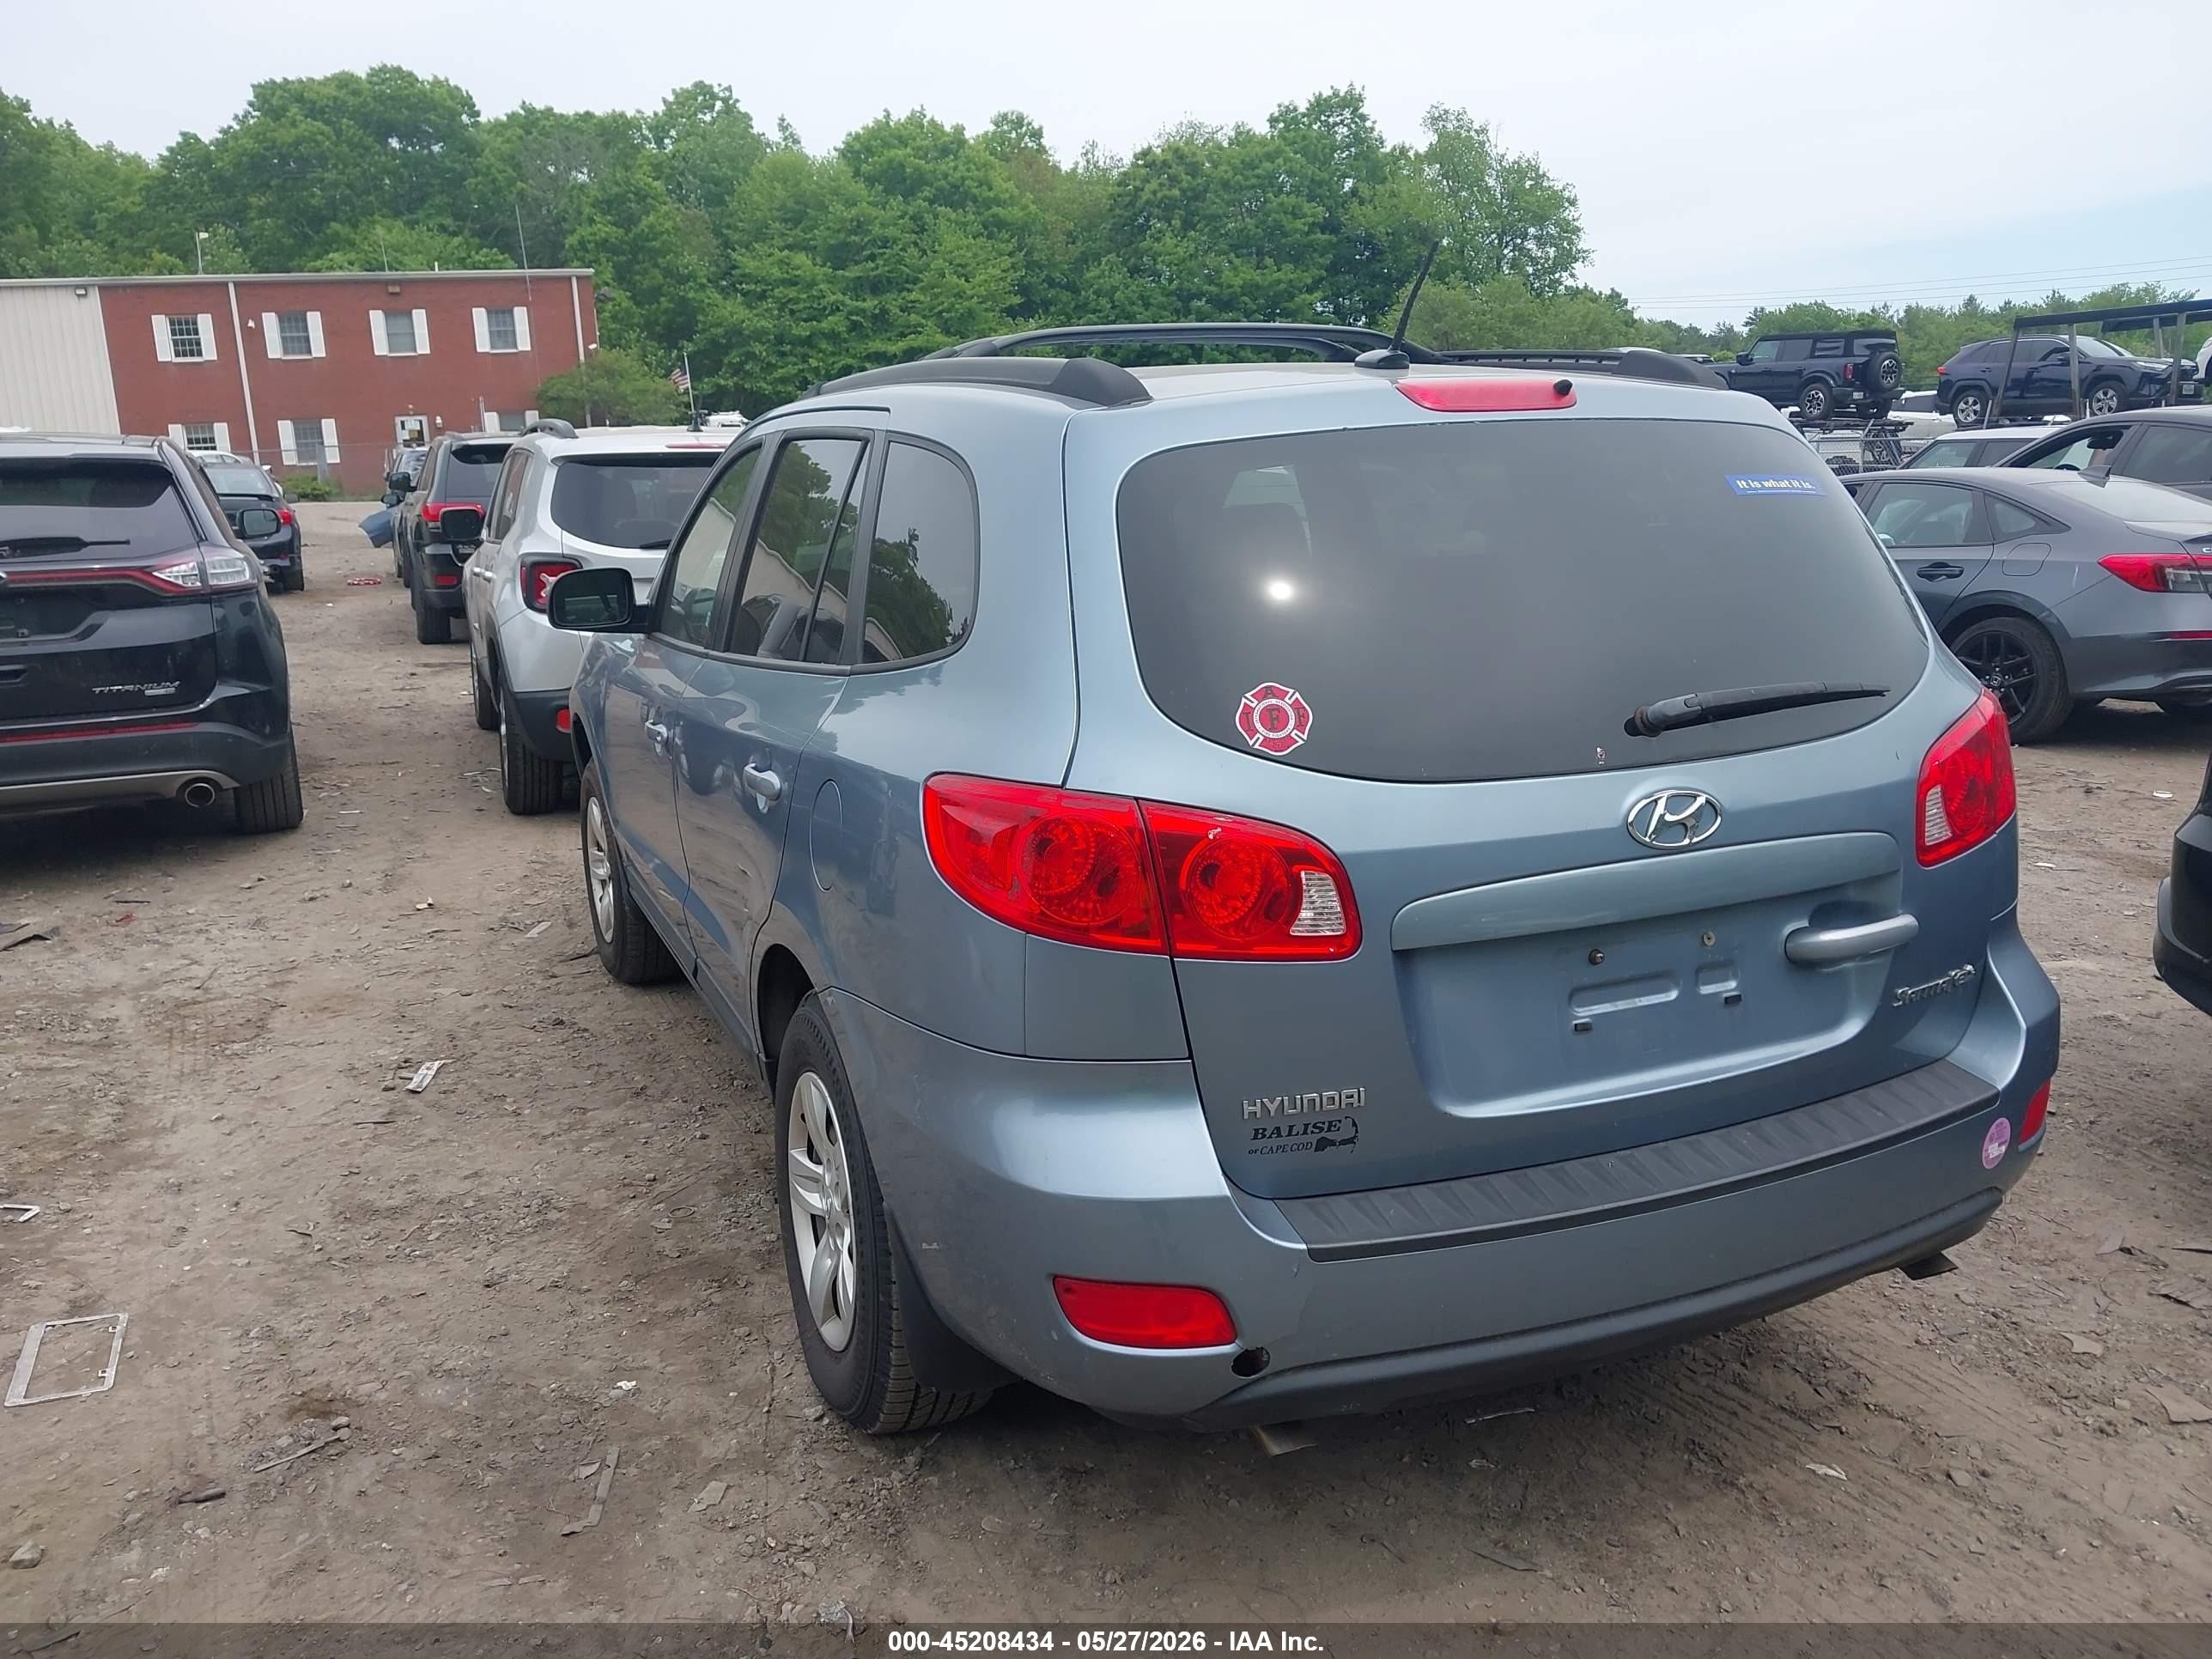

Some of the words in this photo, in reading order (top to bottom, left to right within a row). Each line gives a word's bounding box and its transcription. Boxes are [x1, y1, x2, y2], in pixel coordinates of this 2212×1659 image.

[1761, 479, 1792, 488] what
[1243, 1087, 1365, 1120] HYUNDAI
[1250, 1119, 1342, 1141] BALISE
[1260, 1143, 1289, 1155] CAPE
[1290, 1141, 1313, 1152] COD
